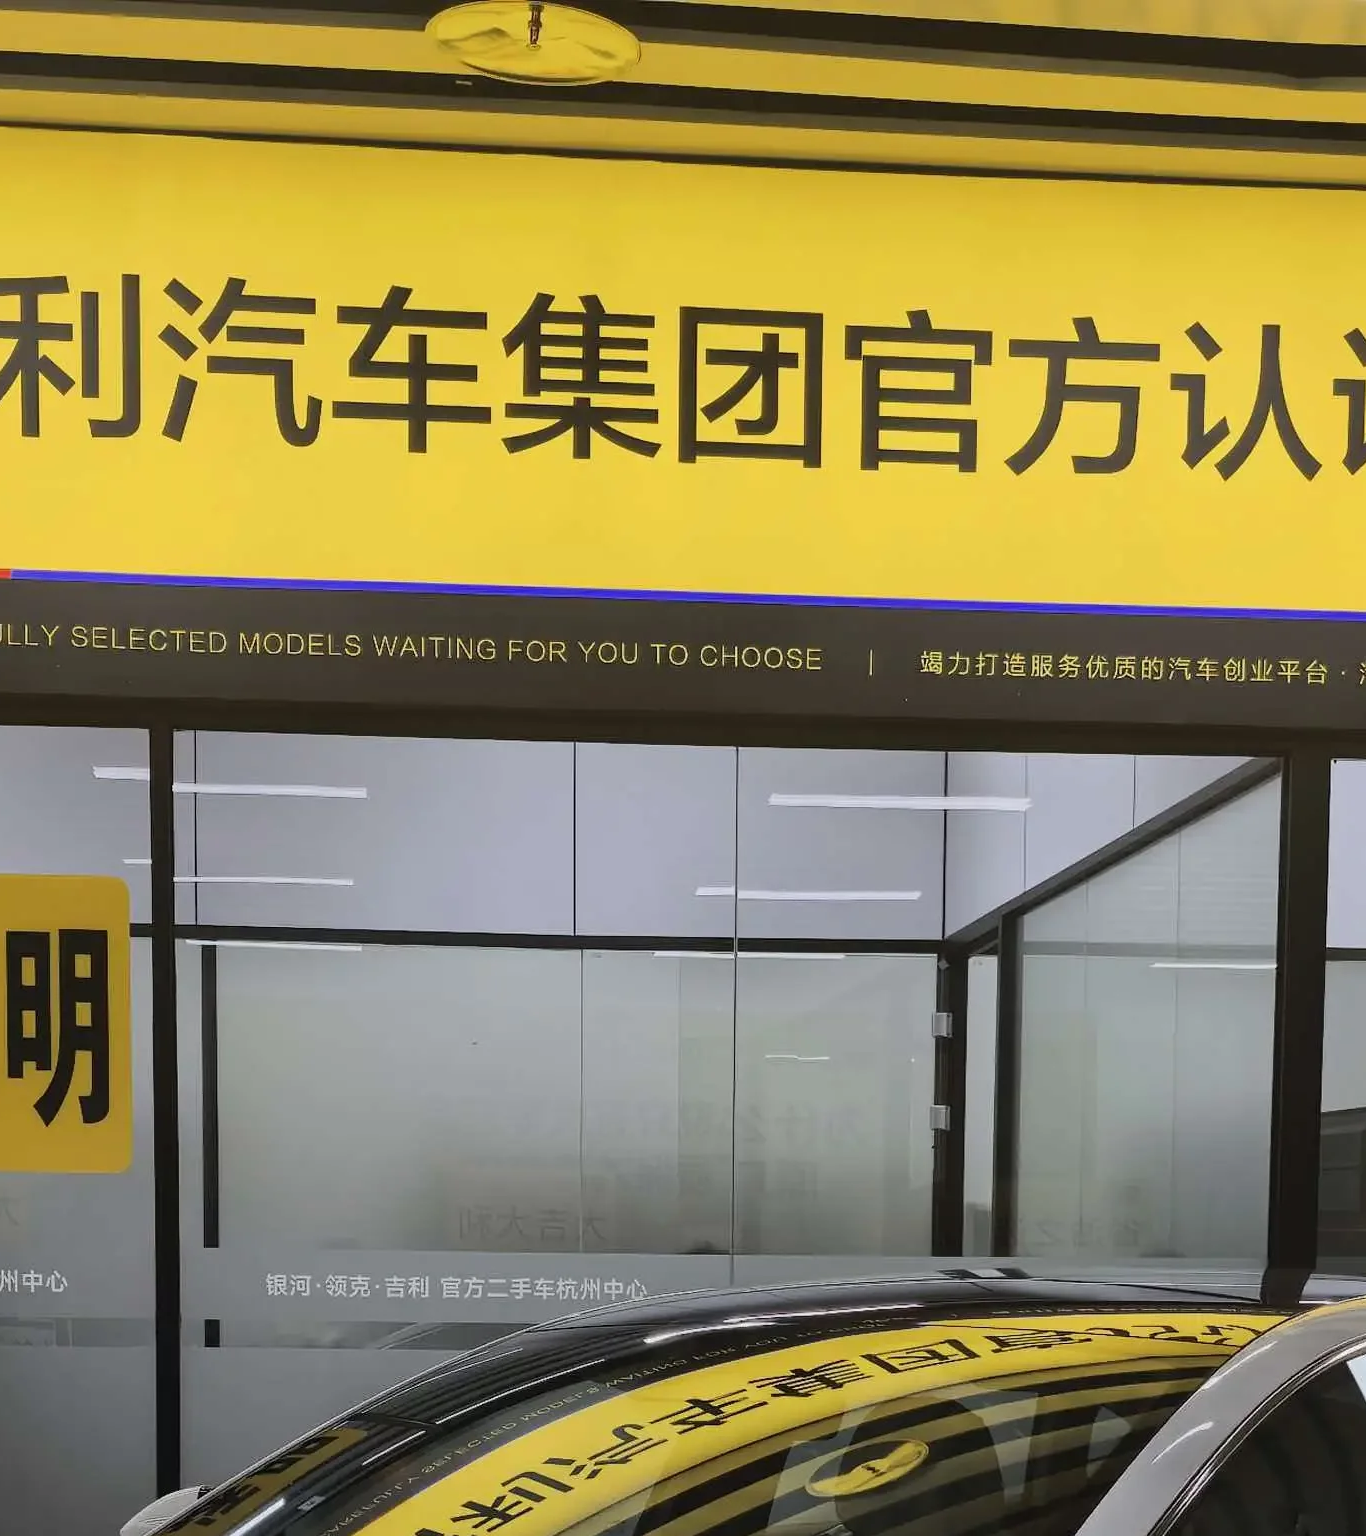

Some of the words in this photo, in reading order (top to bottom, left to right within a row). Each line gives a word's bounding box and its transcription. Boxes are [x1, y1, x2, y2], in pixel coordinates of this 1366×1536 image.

[70, 626, 228, 653] SELECTED
[238, 632, 362, 658] MODELS
[373, 635, 496, 662] WAITING
[508, 640, 568, 663] FOR
[578, 642, 640, 665] YOU
[651, 644, 690, 667] TO
[700, 645, 823, 671] CHOOSE
[439, 1277, 648, 1301] 官方二手车杭州中心
